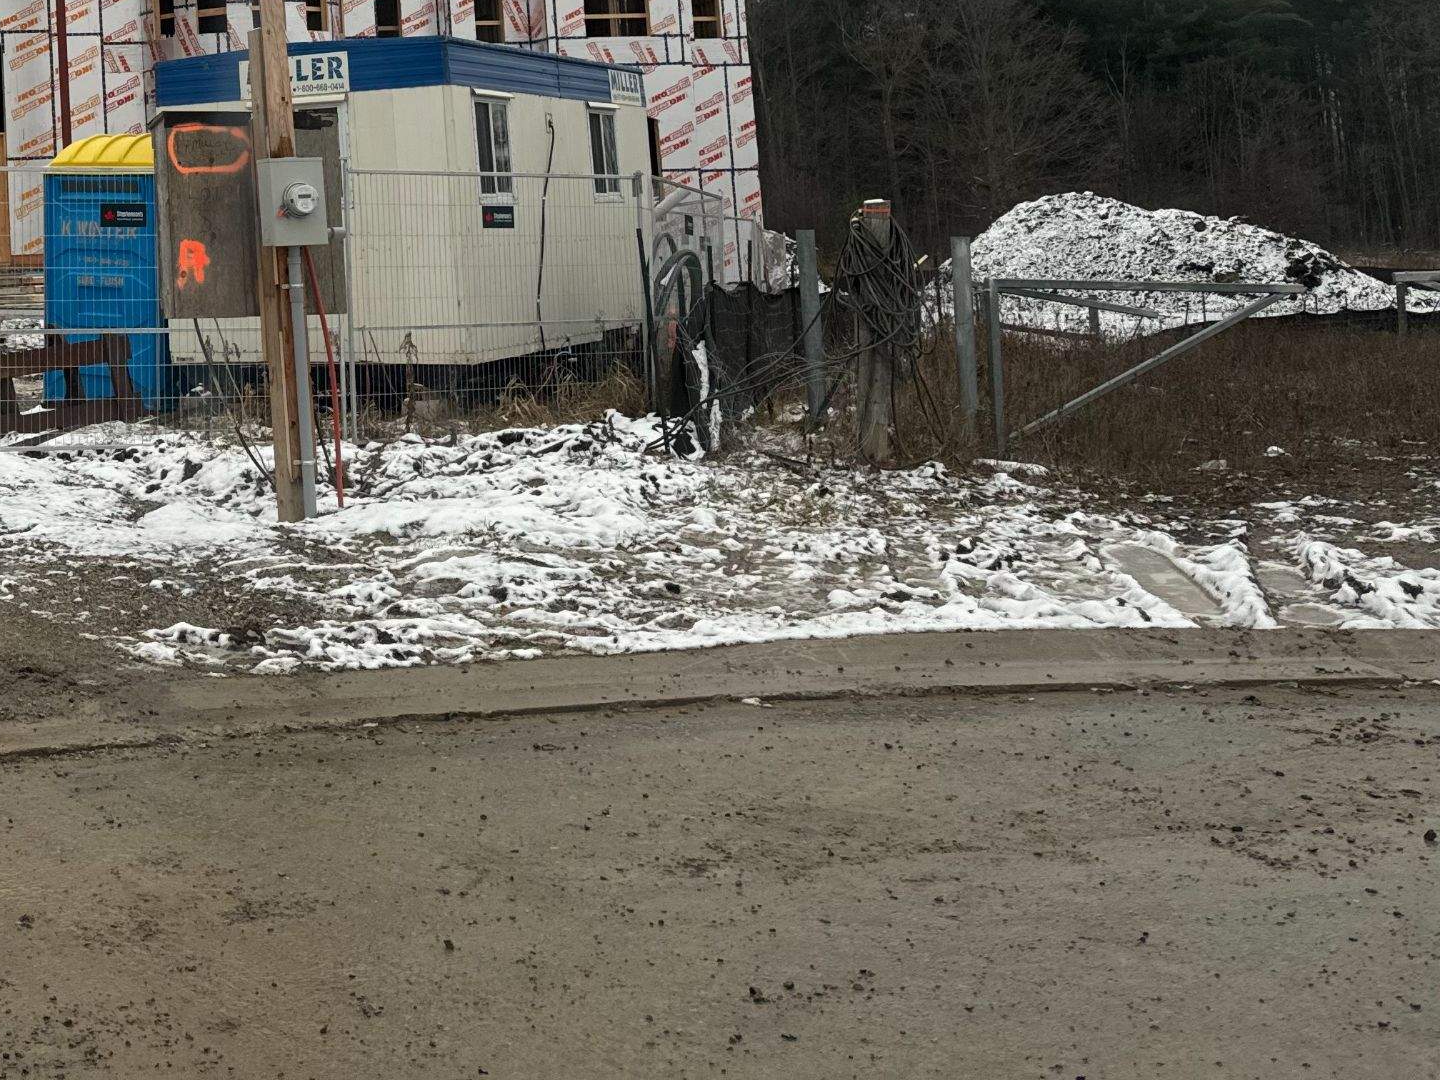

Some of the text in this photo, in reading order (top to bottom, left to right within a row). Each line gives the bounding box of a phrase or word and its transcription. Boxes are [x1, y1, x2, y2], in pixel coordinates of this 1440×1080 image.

[290, 56, 344, 82] LER
[610, 70, 640, 93] MILLER
[77, 113, 96, 126] IKO
[22, 187, 41, 200] IKO
